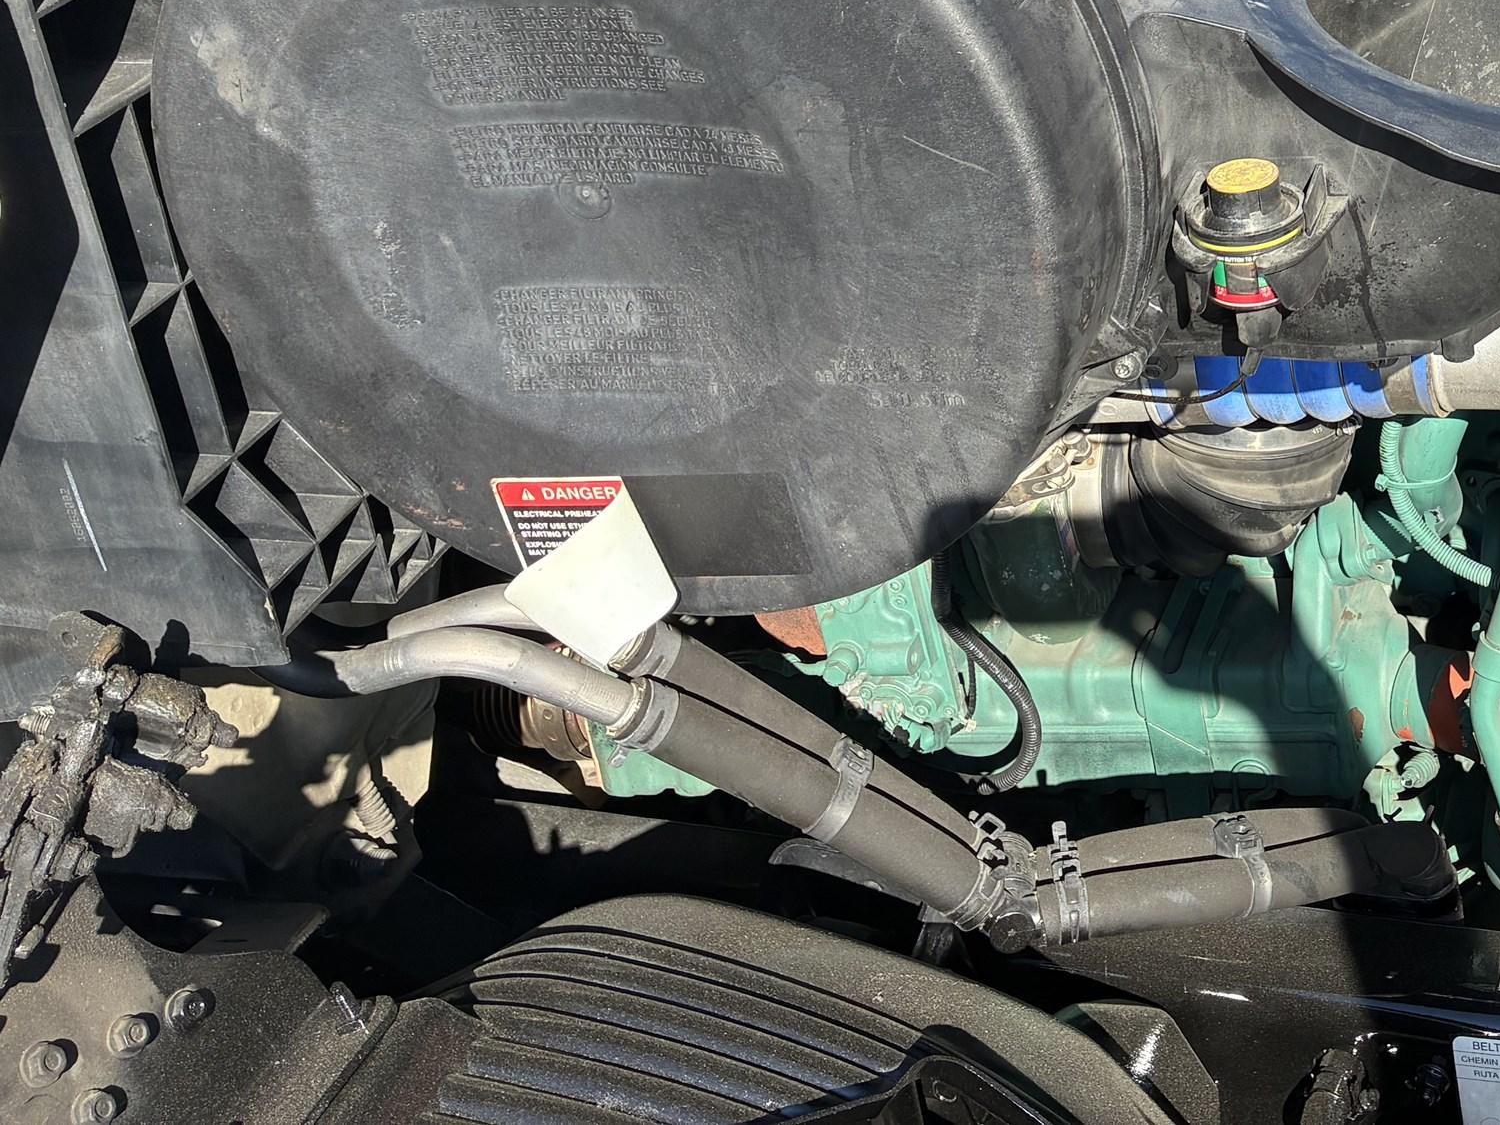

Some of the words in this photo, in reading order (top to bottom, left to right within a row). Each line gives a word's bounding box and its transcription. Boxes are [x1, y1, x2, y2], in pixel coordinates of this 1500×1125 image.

[528, 7, 545, 18] TO
[551, 7, 569, 18] BE
[573, 7, 634, 20] CHANGED
[511, 31, 558, 41] FILTER
[561, 31, 578, 40] TO
[583, 31, 600, 41] BE
[603, 32, 664, 45] CHANGED
[535, 42, 579, 52] EVERY
[600, 42, 648, 55] MONTH
[588, 54, 606, 64] DO
[608, 55, 633, 66] NOT
[638, 56, 681, 69] CLEAN
[556, 66, 618, 77] BETWEEN
[621, 67, 644, 78] THE
[648, 68, 705, 84] CHANGES
[540, 77, 637, 89] INSTRUCTIONS
[640, 79, 667, 92] SEE
[508, 123, 581, 134] PRINCIPAL
[584, 123, 663, 136] CAMBIARSE
[665, 125, 702, 138] CADA
[720, 130, 763, 145] MESES
[512, 135, 600, 147] SECUNDARIO
[682, 139, 718, 153] CADA
[736, 145, 779, 161] MESES
[628, 148, 647, 160] NO
[650, 149, 701, 163] LIMPIAR
[703, 153, 719, 165] EL
[721, 156, 785, 173] ELEMENTO
[640, 161, 707, 176] CONSULTE
[505, 302, 540, 314] TOUS
[543, 302, 569, 313] LES
[507, 327, 543, 338] TOUS
[546, 327, 572, 337] LES
[549, 339, 613, 351] MEILLEUR
[584, 354, 600, 364] LE
[604, 354, 650, 364] FILTRE
[580, 378, 599, 389] AU
[541, 486, 617, 500] DANGER
[513, 510, 565, 518] ELECTRICAL
[518, 522, 531, 530] DO
[532, 522, 549, 530] NOT
[550, 522, 567, 530] USE
[1472, 1041, 1500, 1053] BELT
[1461, 1055, 1499, 1067] CHEMIN
[1473, 1069, 1500, 1078] RUTA
